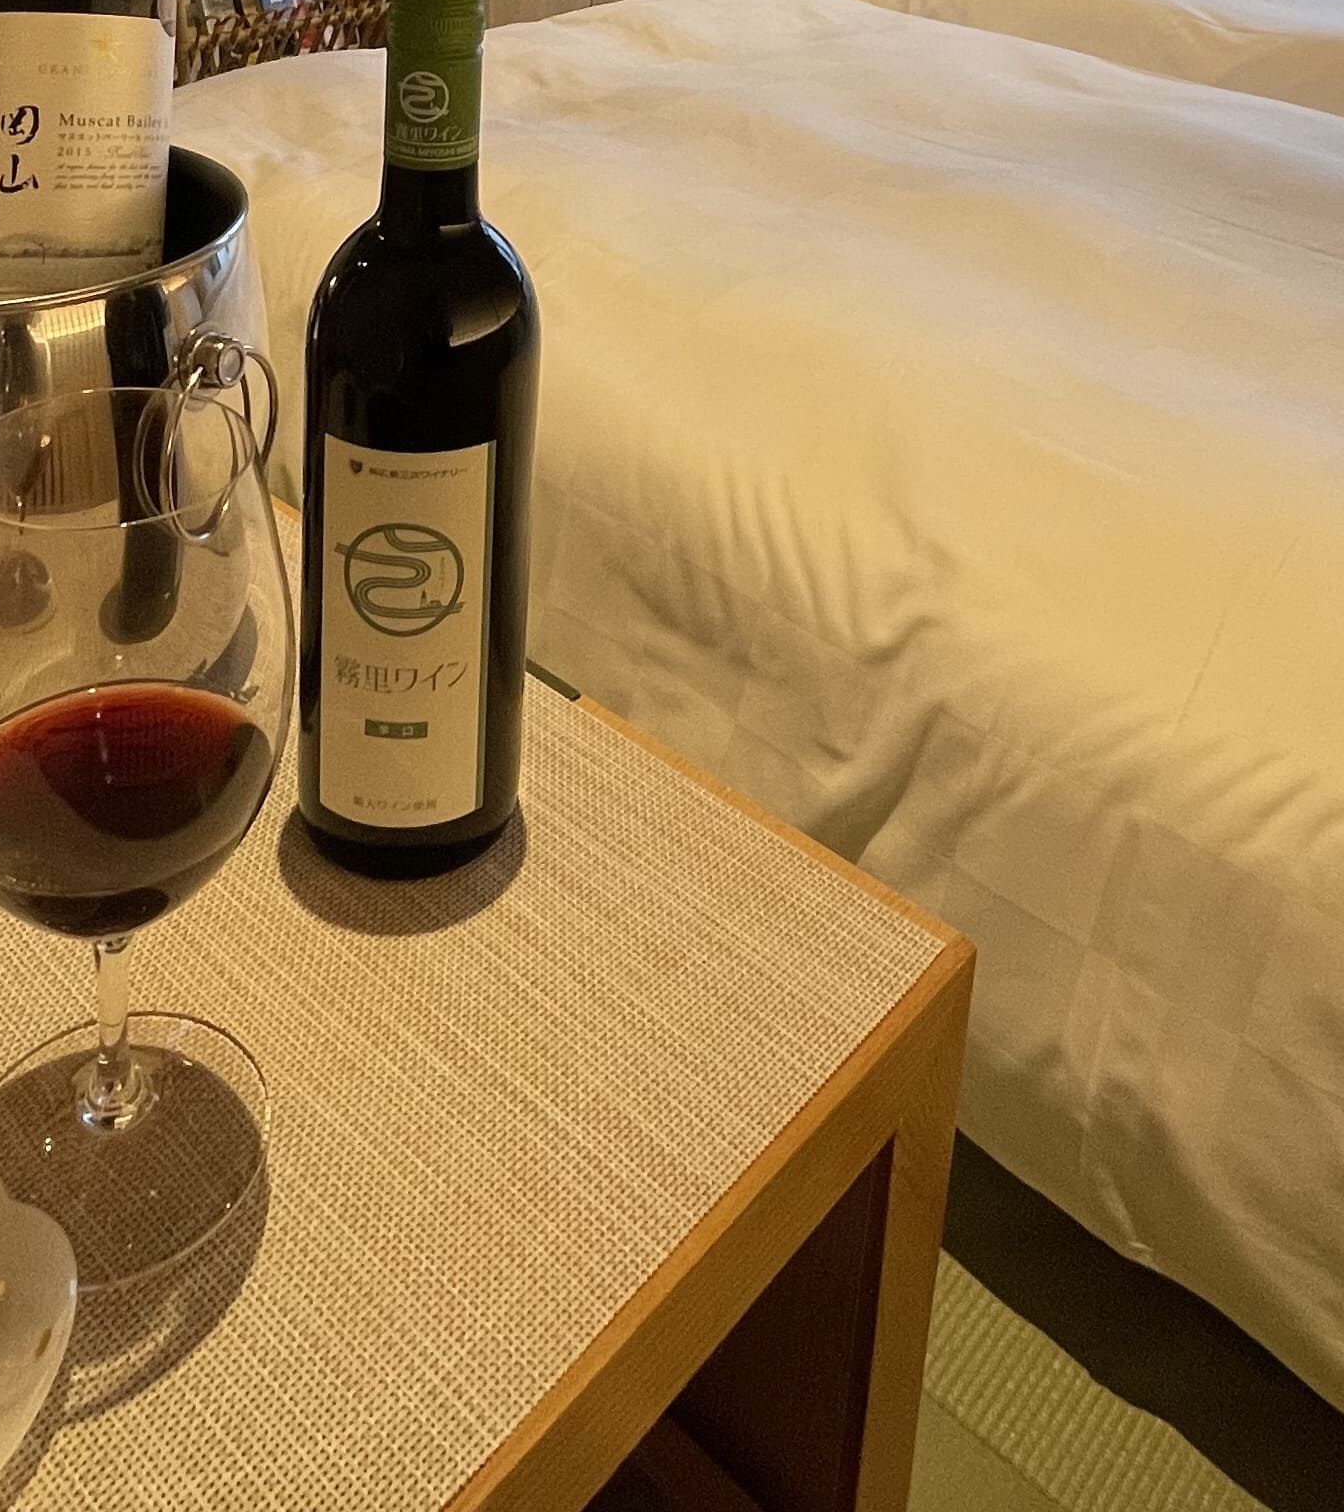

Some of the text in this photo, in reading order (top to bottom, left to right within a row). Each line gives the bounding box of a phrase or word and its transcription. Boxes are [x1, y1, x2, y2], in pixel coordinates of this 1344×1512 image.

[59, 112, 121, 128] Muscat
[333, 654, 469, 694] 霧里ワイン
